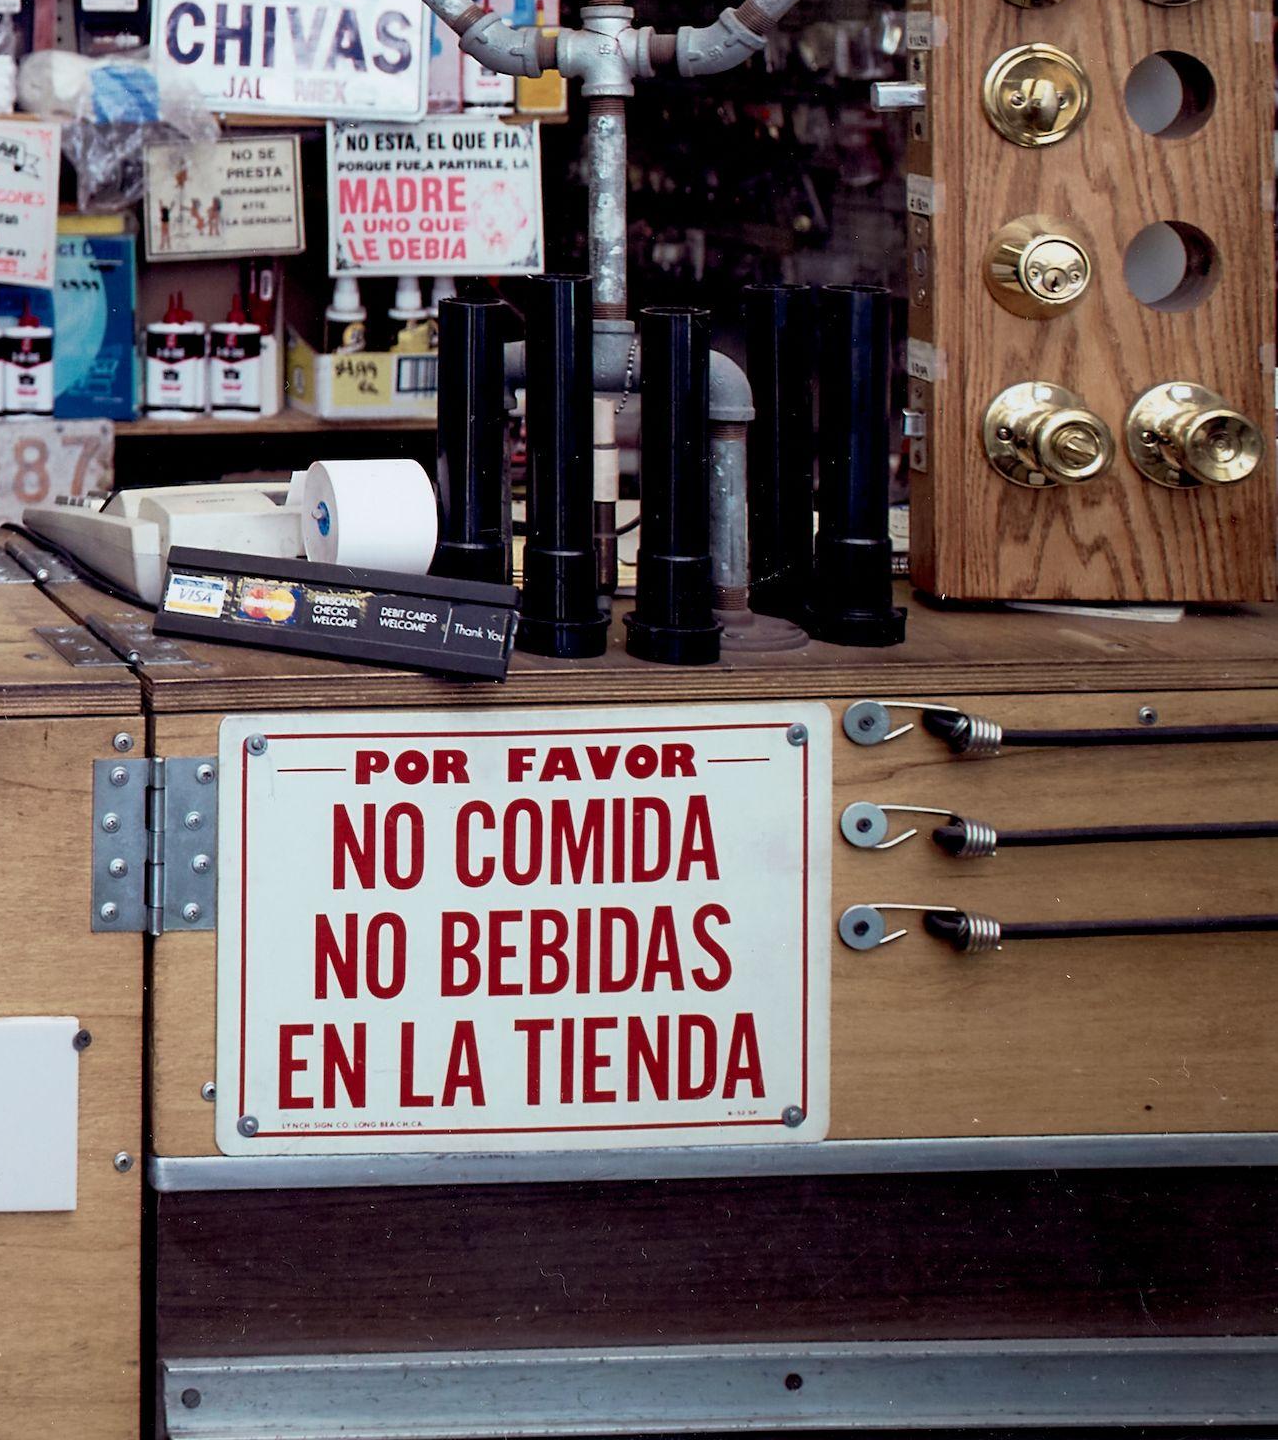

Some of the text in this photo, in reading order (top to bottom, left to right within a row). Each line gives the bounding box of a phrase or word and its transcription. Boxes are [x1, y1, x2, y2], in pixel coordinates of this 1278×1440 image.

[165, 1, 414, 75] CHIVAS
[222, 76, 267, 102] JAL
[346, 133, 369, 152] NO
[374, 132, 422, 153] ESTA,
[427, 131, 448, 151] EL
[452, 131, 488, 151] QUE
[231, 147, 276, 161] NO SE
[226, 165, 283, 180] PRESTA
[337, 160, 392, 172] PORQUE
[338, 176, 467, 215] MADRE
[341, 217, 468, 234] A UNO QUE
[347, 237, 468, 263] LE DEBIA
[177, 587, 214, 605] VISA
[313, 595, 361, 609] PERSONAL
[311, 605, 350, 618] CHECKS
[380, 606, 439, 625] DEBIT CARDS
[310, 614, 359, 630] WELCOME
[378, 616, 427, 634] WELCOME
[453, 622, 506, 644] Thank You
[354, 743, 699, 786] POR FAVOR
[331, 794, 721, 892] NO COMIDA
[313, 901, 733, 1001] NO BEBIDAS
[277, 1012, 767, 1111] EN LA TIENDA
[281, 1121, 311, 1130] LYNCH
[313, 1121, 334, 1130] SIGN
[353, 1120, 377, 1129] LONG
